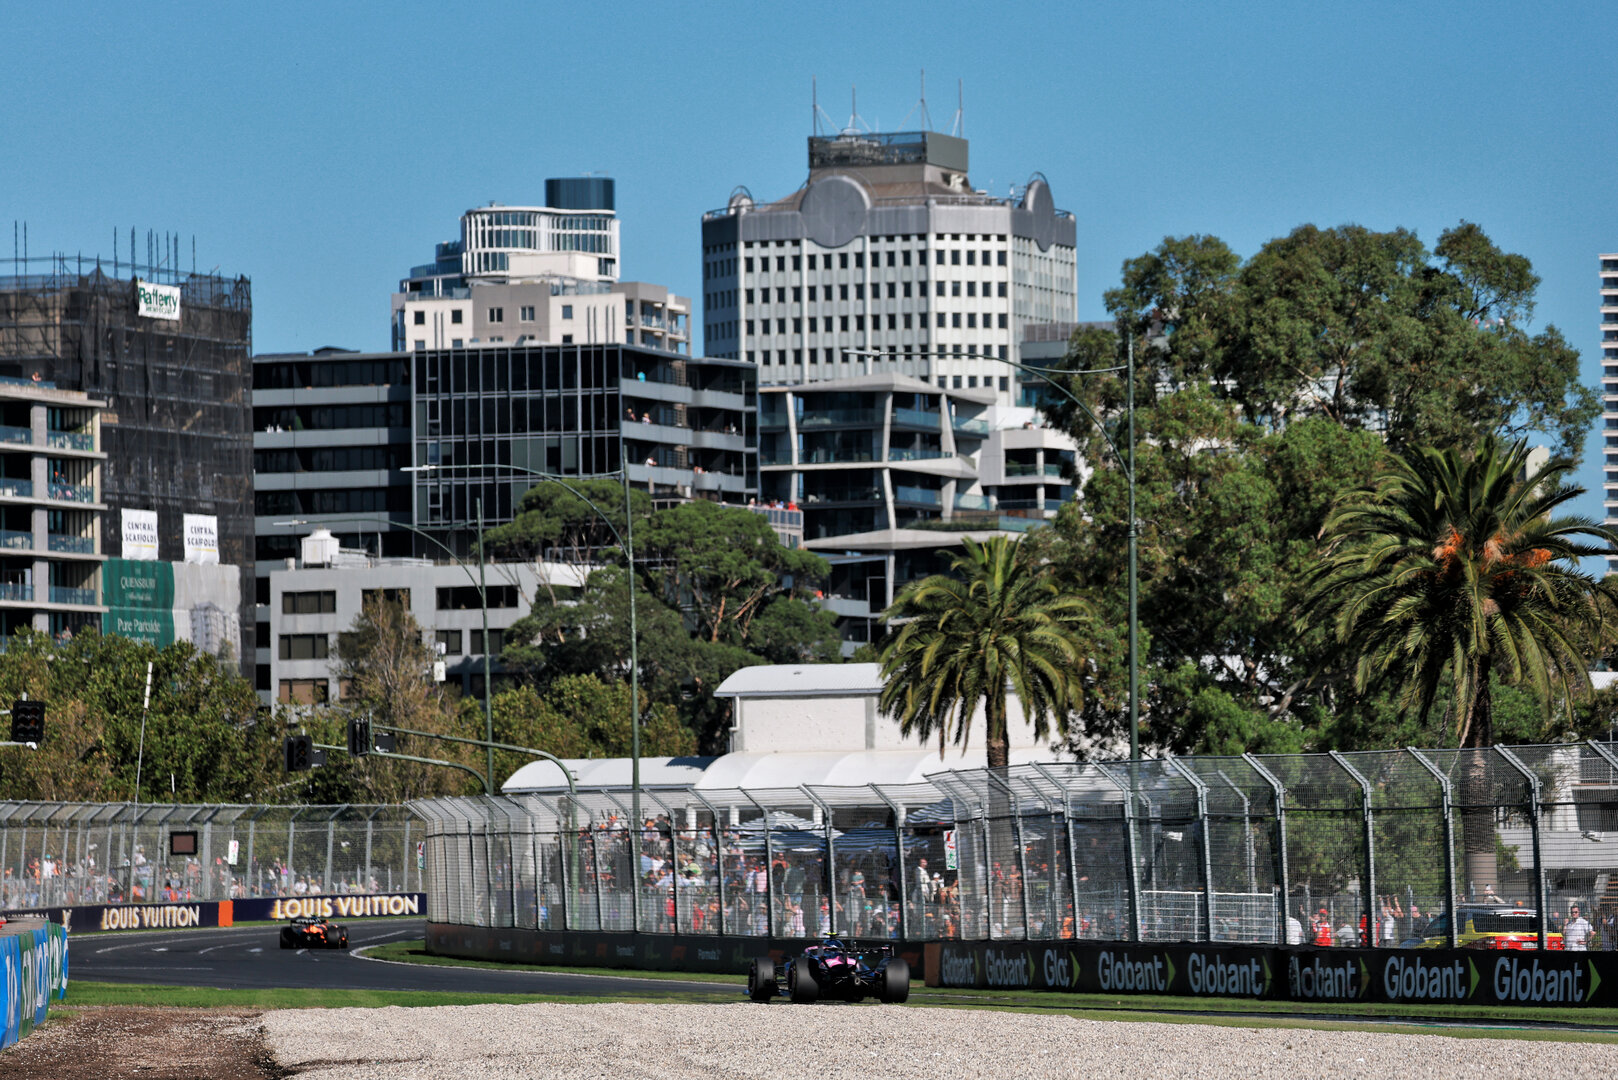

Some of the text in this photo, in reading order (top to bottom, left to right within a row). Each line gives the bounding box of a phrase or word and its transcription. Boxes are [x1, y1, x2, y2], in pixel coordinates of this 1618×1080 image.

[138, 287, 178, 312] Rafferty
[127, 521, 154, 531] CENTRAL
[117, 617, 133, 632] Pure
[101, 905, 200, 930] LOUIS VUITTON
[275, 894, 419, 919] LOUIS VUITTON
[985, 949, 1029, 986] Globant
[1098, 951, 1166, 990] Globant
[1188, 952, 1263, 995] Globant
[1384, 955, 1466, 999] Globant
[1494, 956, 1583, 1002] Globant
